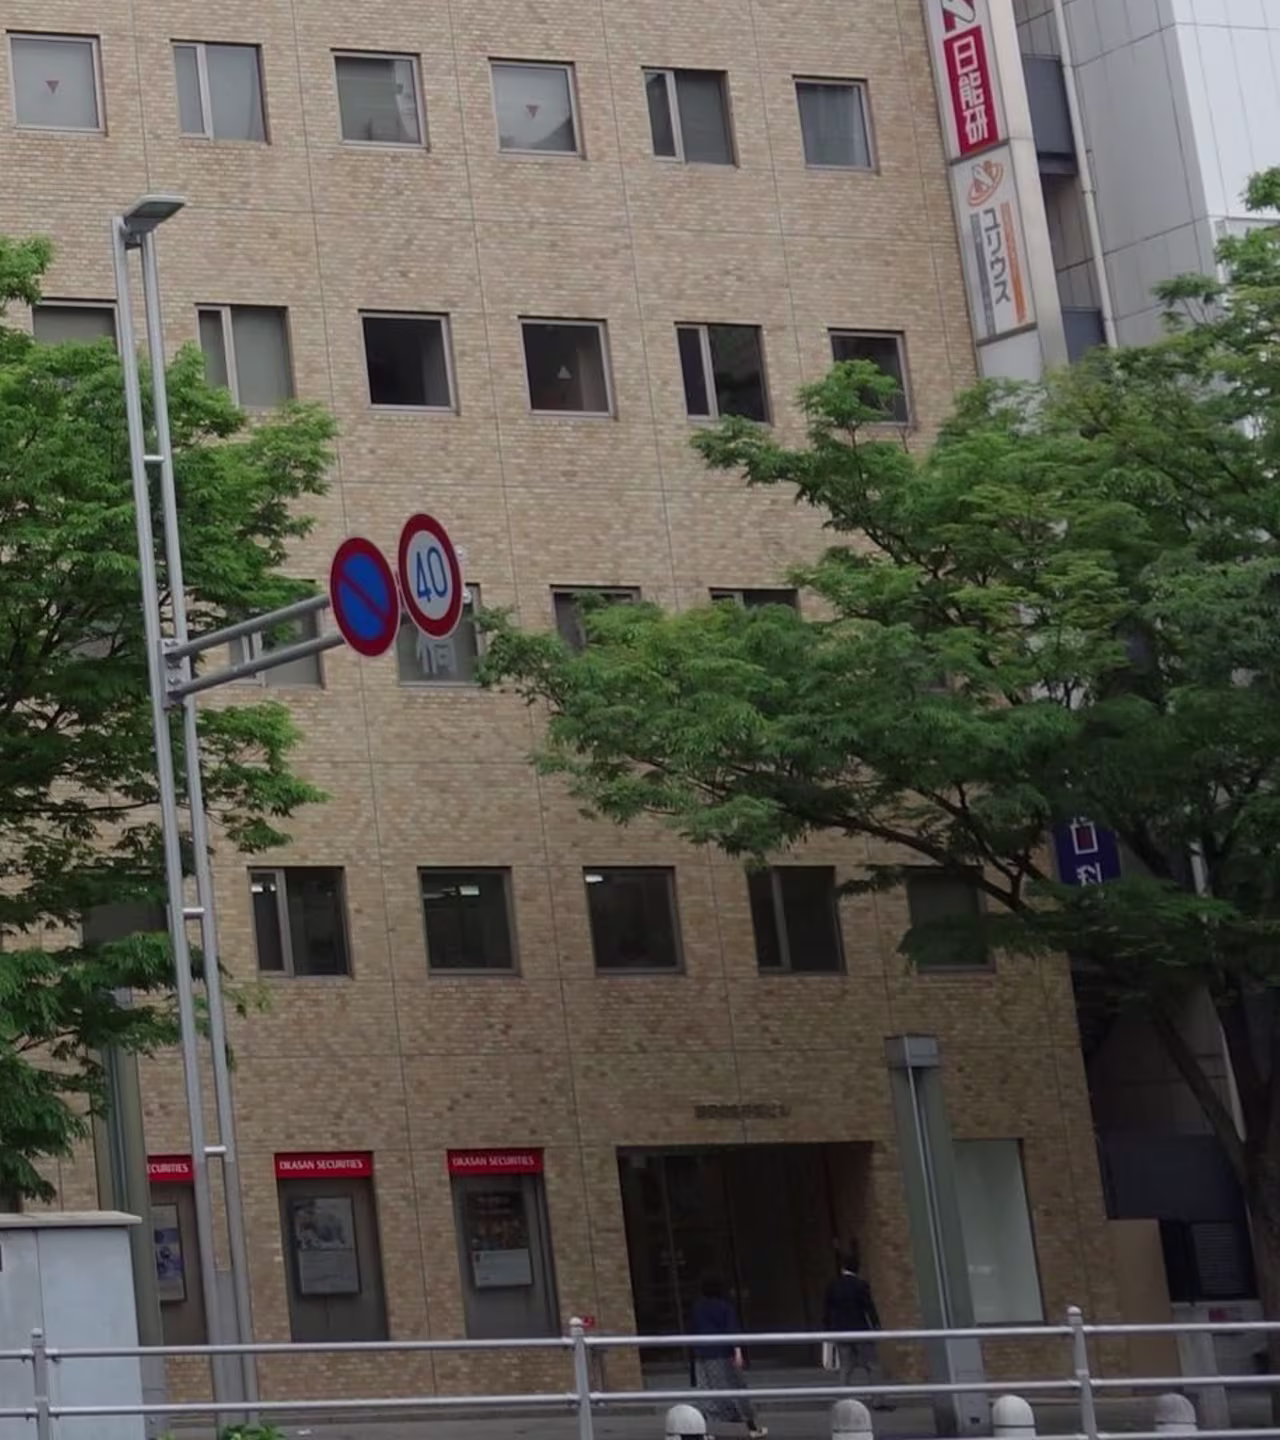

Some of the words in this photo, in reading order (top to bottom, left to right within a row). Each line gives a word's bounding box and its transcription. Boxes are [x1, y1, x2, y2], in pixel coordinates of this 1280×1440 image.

[953, 35, 989, 145] 日能研
[983, 207, 1010, 304] ユリウス
[416, 546, 448, 604] 40
[317, 1160, 363, 1169] SECURITIES
